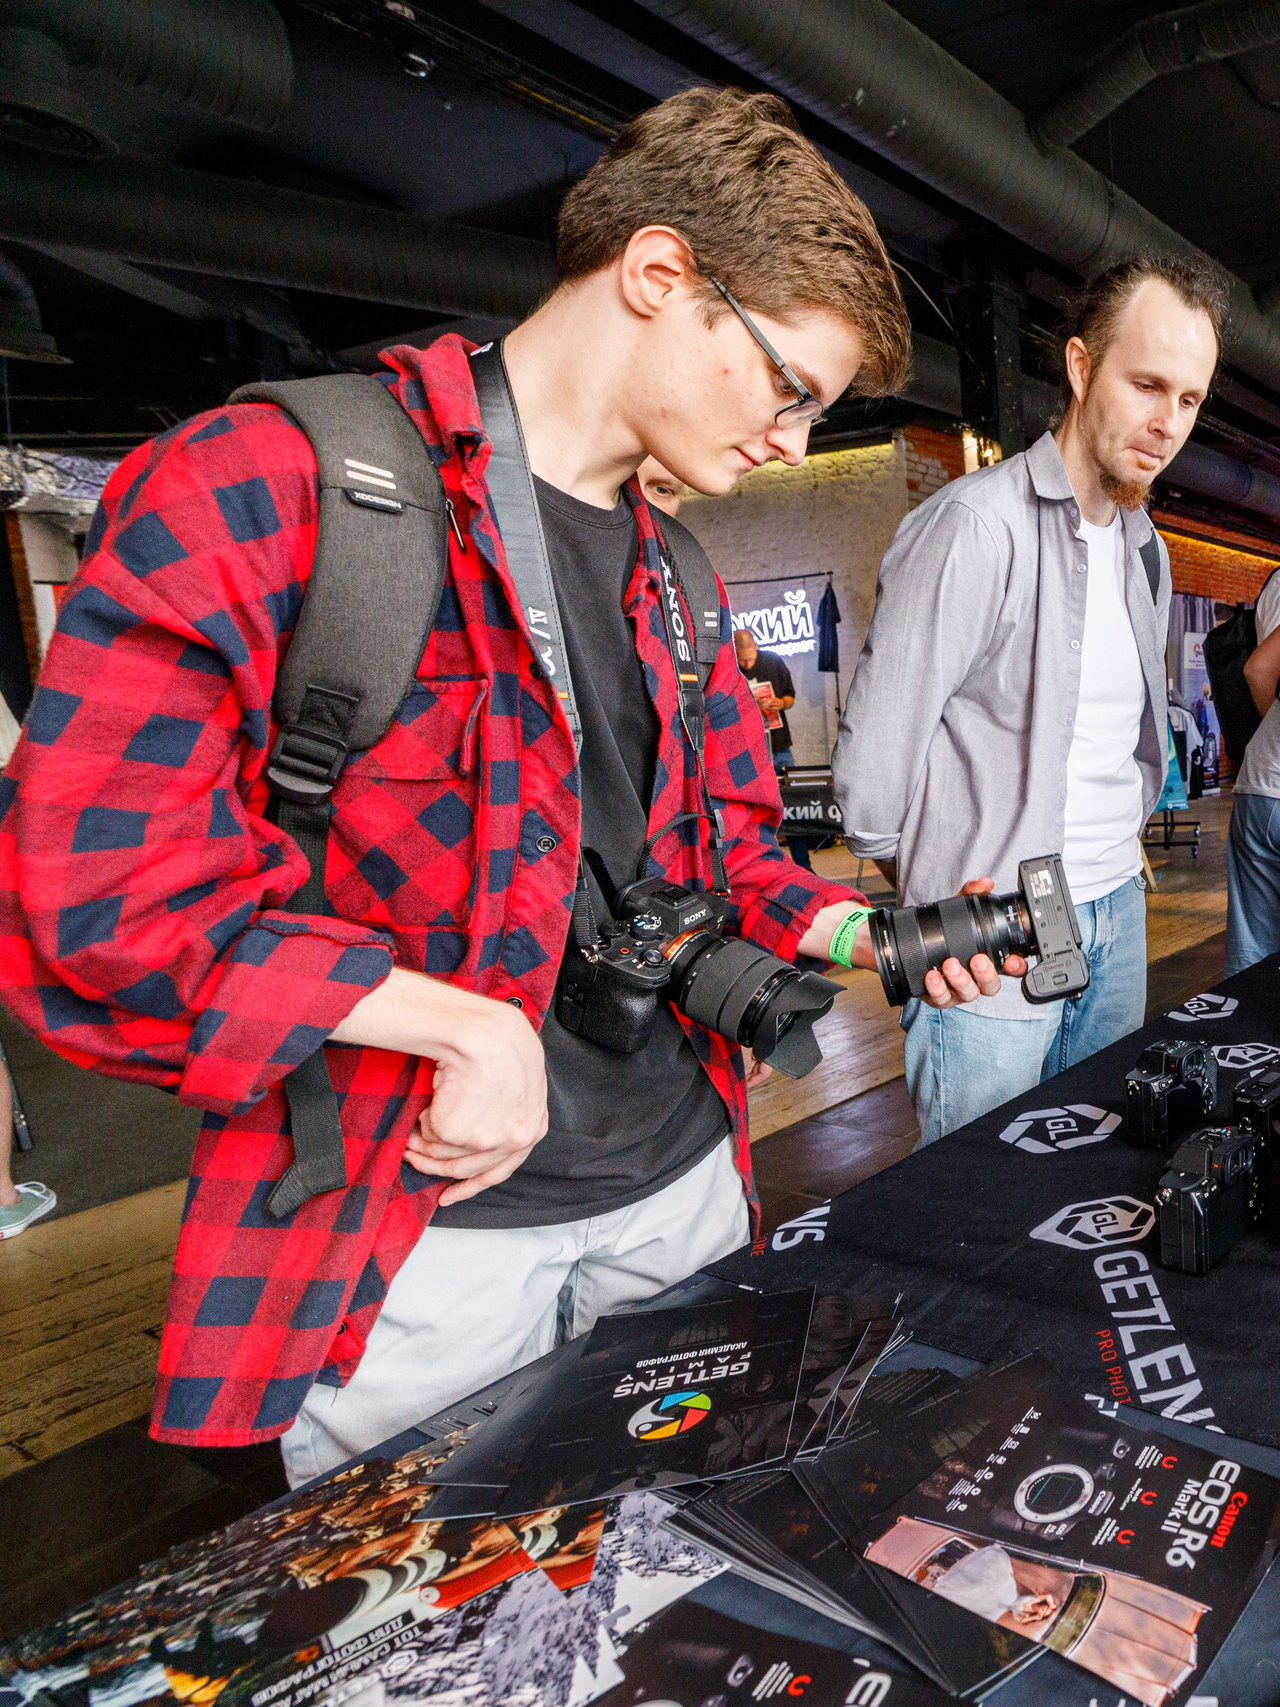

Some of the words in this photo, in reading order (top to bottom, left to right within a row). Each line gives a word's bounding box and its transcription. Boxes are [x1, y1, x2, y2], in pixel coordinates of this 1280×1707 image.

[660, 555, 691, 662] SONY
[783, 800, 823, 821] кий
[683, 908, 707, 926] SONY
[1183, 998, 1209, 1017] GL
[1044, 1116, 1080, 1142] GL
[1092, 1211, 1120, 1234] GL
[635, 1351, 699, 1369] ФОТОГРАФОВ
[698, 1341, 748, 1357] АКАДЕМИЯ
[1093, 1250, 1226, 1434] GETLEN
[1095, 1328, 1118, 1364] PRO
[612, 1361, 751, 1399] GETLENS
[1106, 1365, 1133, 1405] PHOT
[1167, 1478, 1203, 1520] Mark
[1186, 1459, 1242, 1530] EOS
[1160, 1518, 1183, 1534] II
[1209, 1491, 1249, 1549] Canon
[1164, 1527, 1210, 1571] R6
[370, 1615, 404, 1642] ДЛЯ
[393, 1625, 424, 1648] ТОТ
[250, 1636, 369, 1706] ФОТОГРАФОВ
[331, 1642, 392, 1679] САМЫЙ
